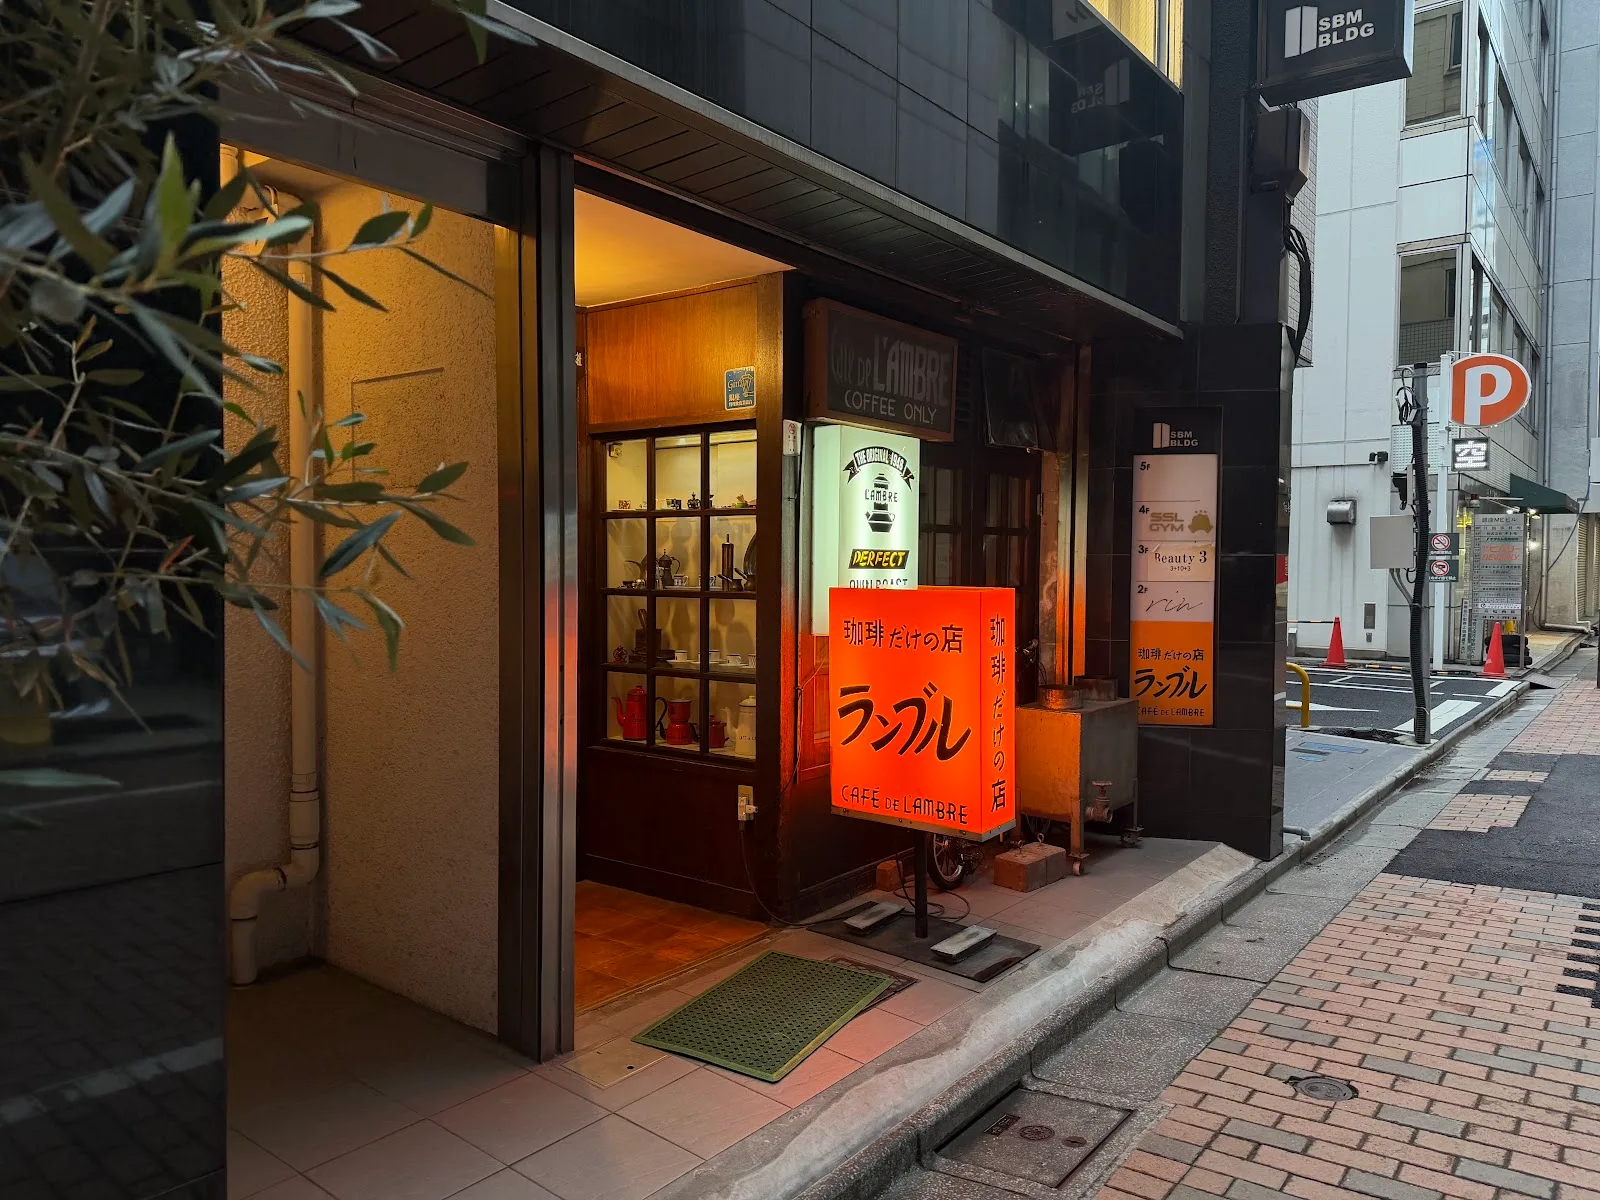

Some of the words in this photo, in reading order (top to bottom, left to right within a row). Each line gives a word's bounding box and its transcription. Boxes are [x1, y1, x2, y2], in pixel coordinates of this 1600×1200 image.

[1318, 8, 1363, 31] SBM
[1318, 22, 1375, 48] BLDG
[1463, 364, 1513, 426] P
[844, 389, 896, 417] COFFEE
[904, 402, 937, 425] ONLY
[1170, 439, 1199, 447] BLDG
[1455, 440, 1487, 468] 空
[1139, 461, 1151, 471] 5F
[865, 488, 898, 503] L'AMBRE
[1138, 505, 1150, 515] 4F
[1150, 512, 1185, 522] SSL
[1150, 523, 1184, 532] GYM
[1138, 544, 1149, 554] 3F
[852, 550, 906, 568] PERFECT
[1154, 552, 1195, 565] Beauty
[1199, 550, 1207, 564] 3
[1137, 584, 1149, 594] 2F
[843, 617, 964, 653] 珈琲だけの店
[1138, 648, 1205, 661] 珈琲だけの店
[1134, 664, 1208, 699] ランブル
[989, 613, 1007, 813] 珈琲だけの店
[1171, 707, 1205, 717] L'AMBRE
[837, 681, 972, 761] ランブル
[885, 796, 900, 812] DE
[903, 795, 968, 825] L'AMBRE
